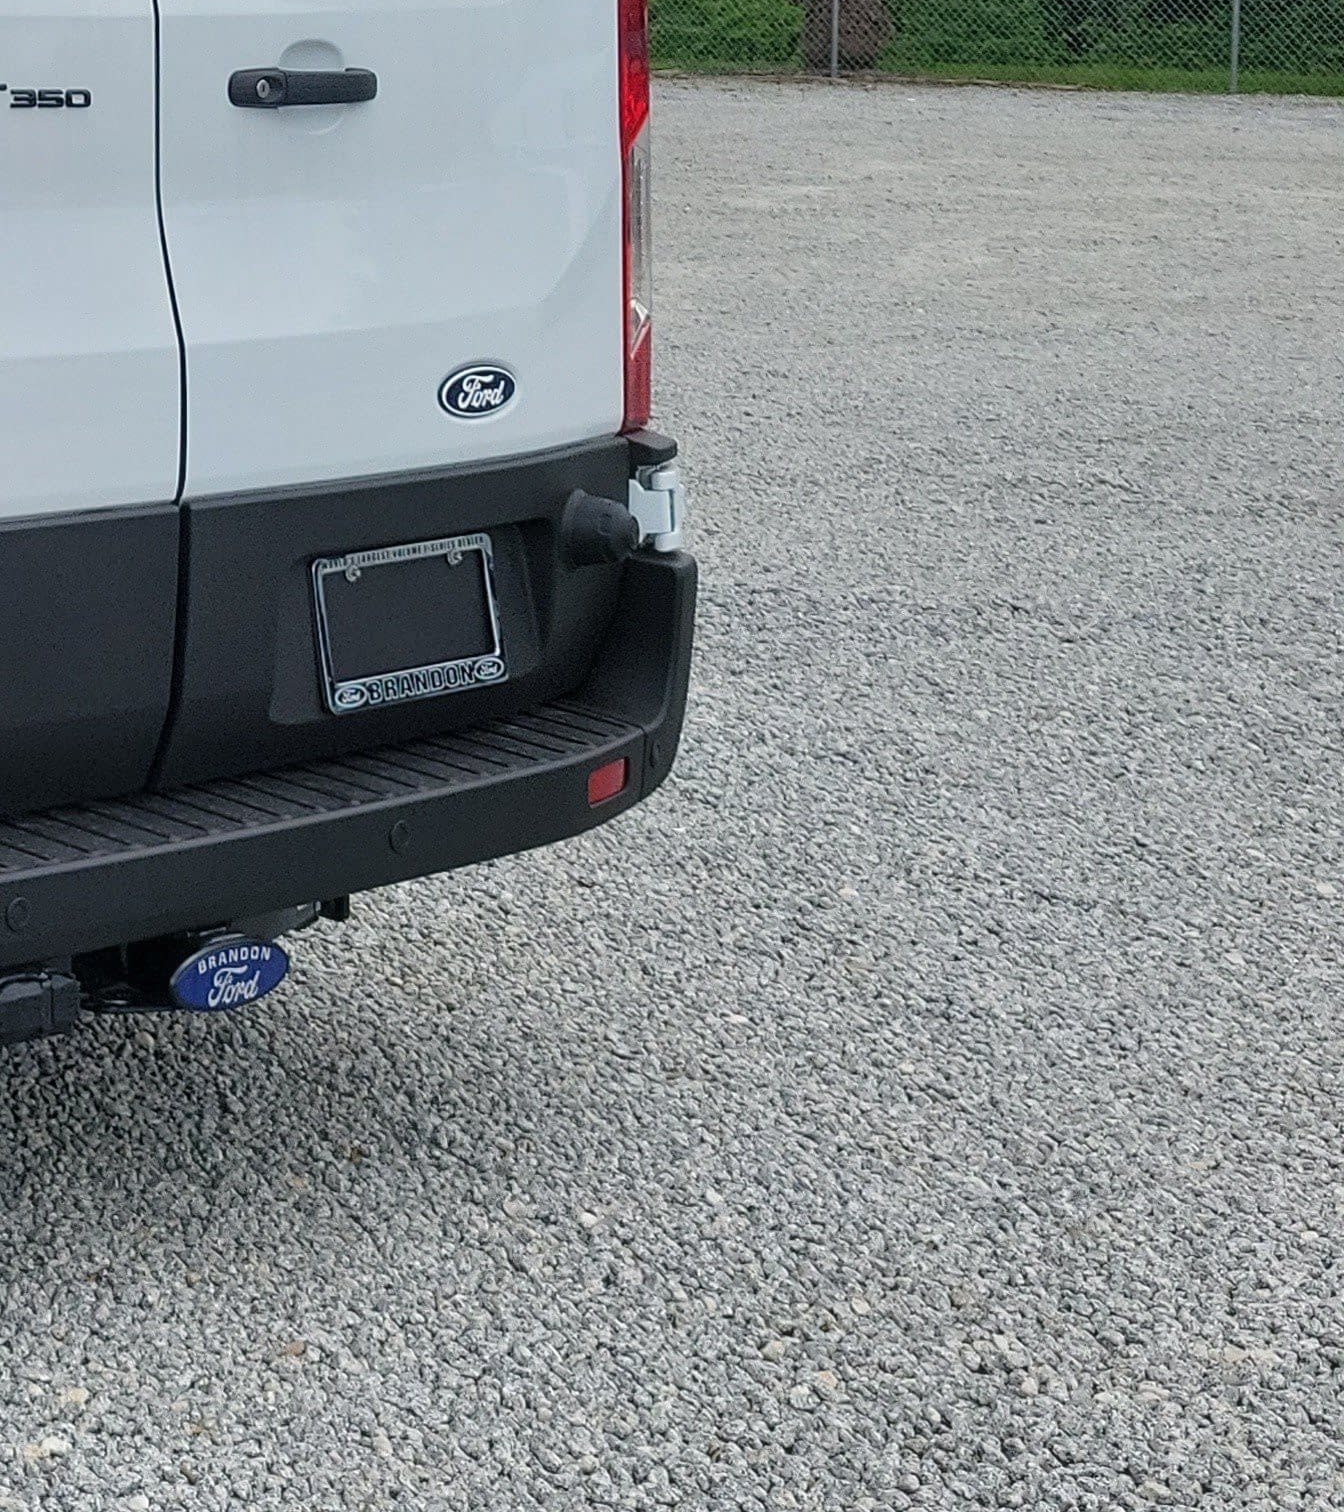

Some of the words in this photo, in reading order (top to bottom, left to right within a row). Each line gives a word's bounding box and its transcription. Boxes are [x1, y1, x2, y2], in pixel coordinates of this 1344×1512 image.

[458, 375, 505, 408] Ford
[366, 662, 475, 704] BRANDON
[198, 946, 271, 974] BRANDON
[208, 965, 260, 1007] Ford
